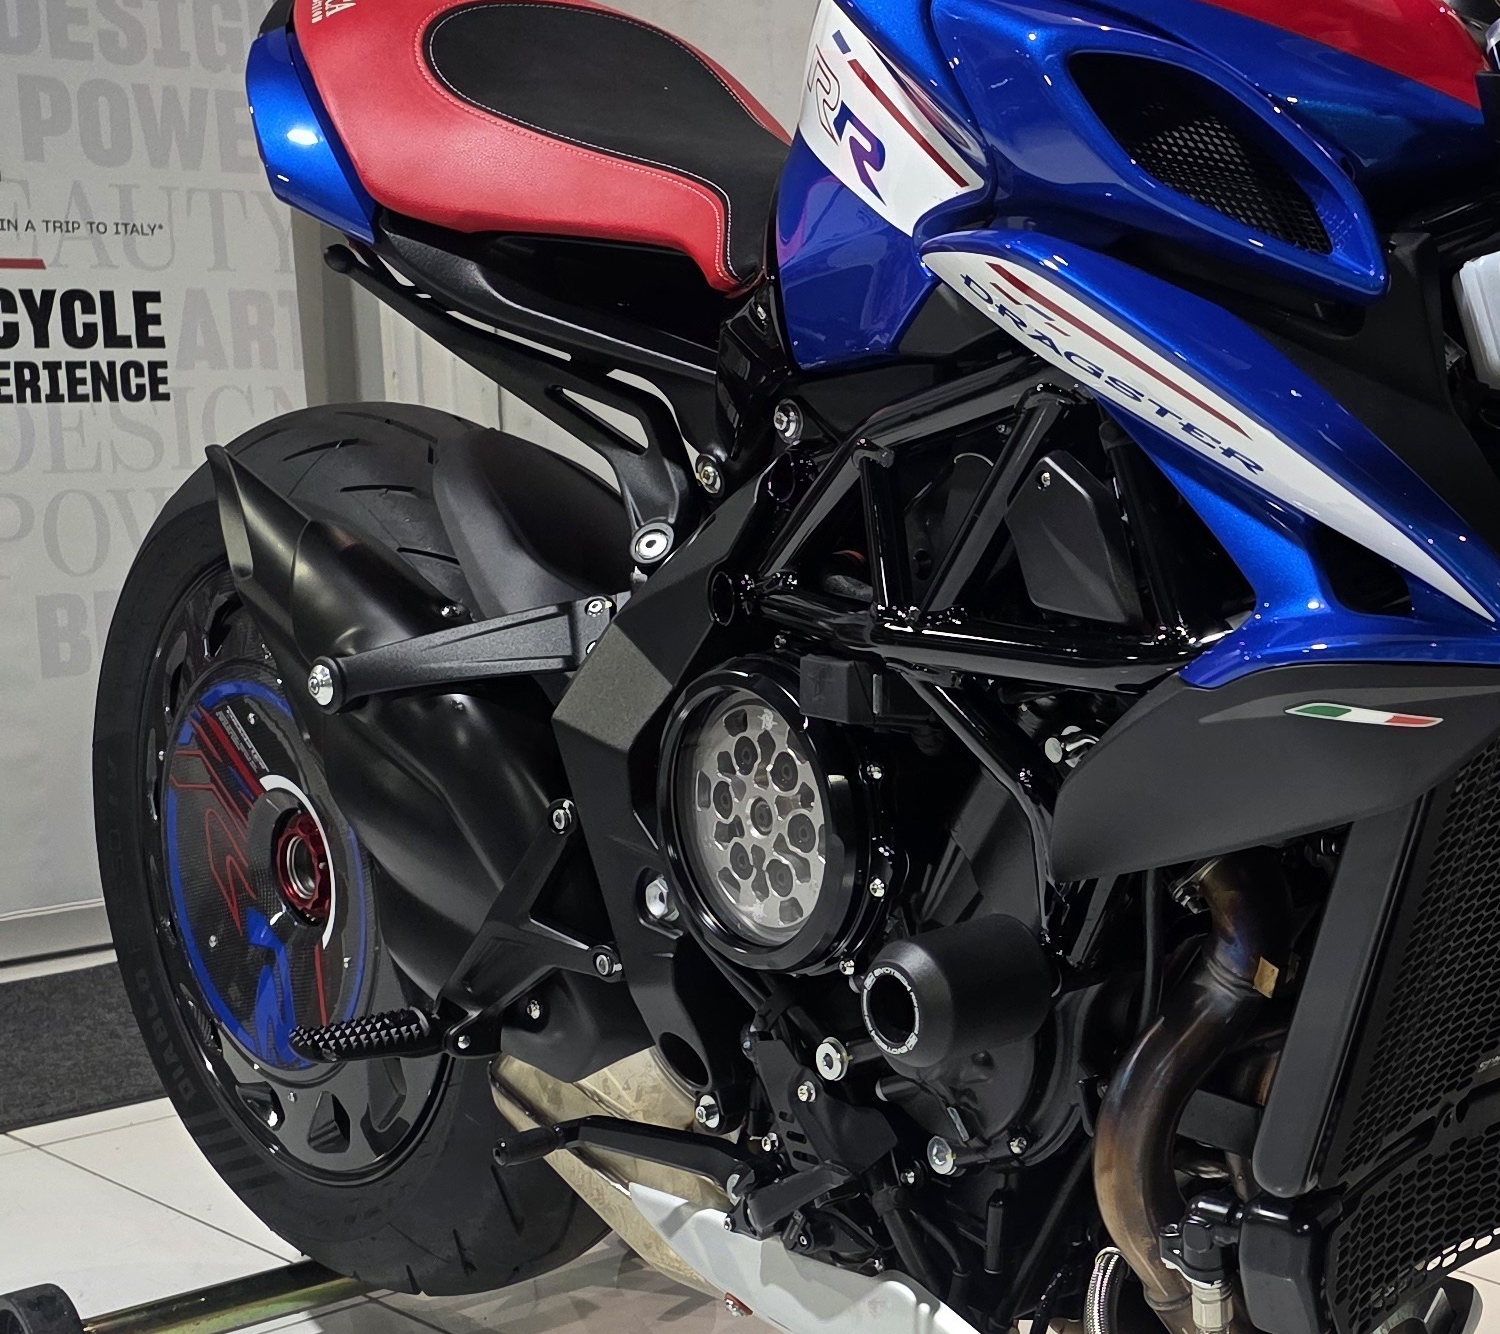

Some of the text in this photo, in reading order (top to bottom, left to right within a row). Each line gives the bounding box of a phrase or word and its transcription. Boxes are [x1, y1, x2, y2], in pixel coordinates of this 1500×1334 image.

[25, 219, 36, 233] A
[42, 219, 81, 234] TRIP
[87, 220, 108, 235] TO
[959, 273, 1265, 476] DRAGSTER
